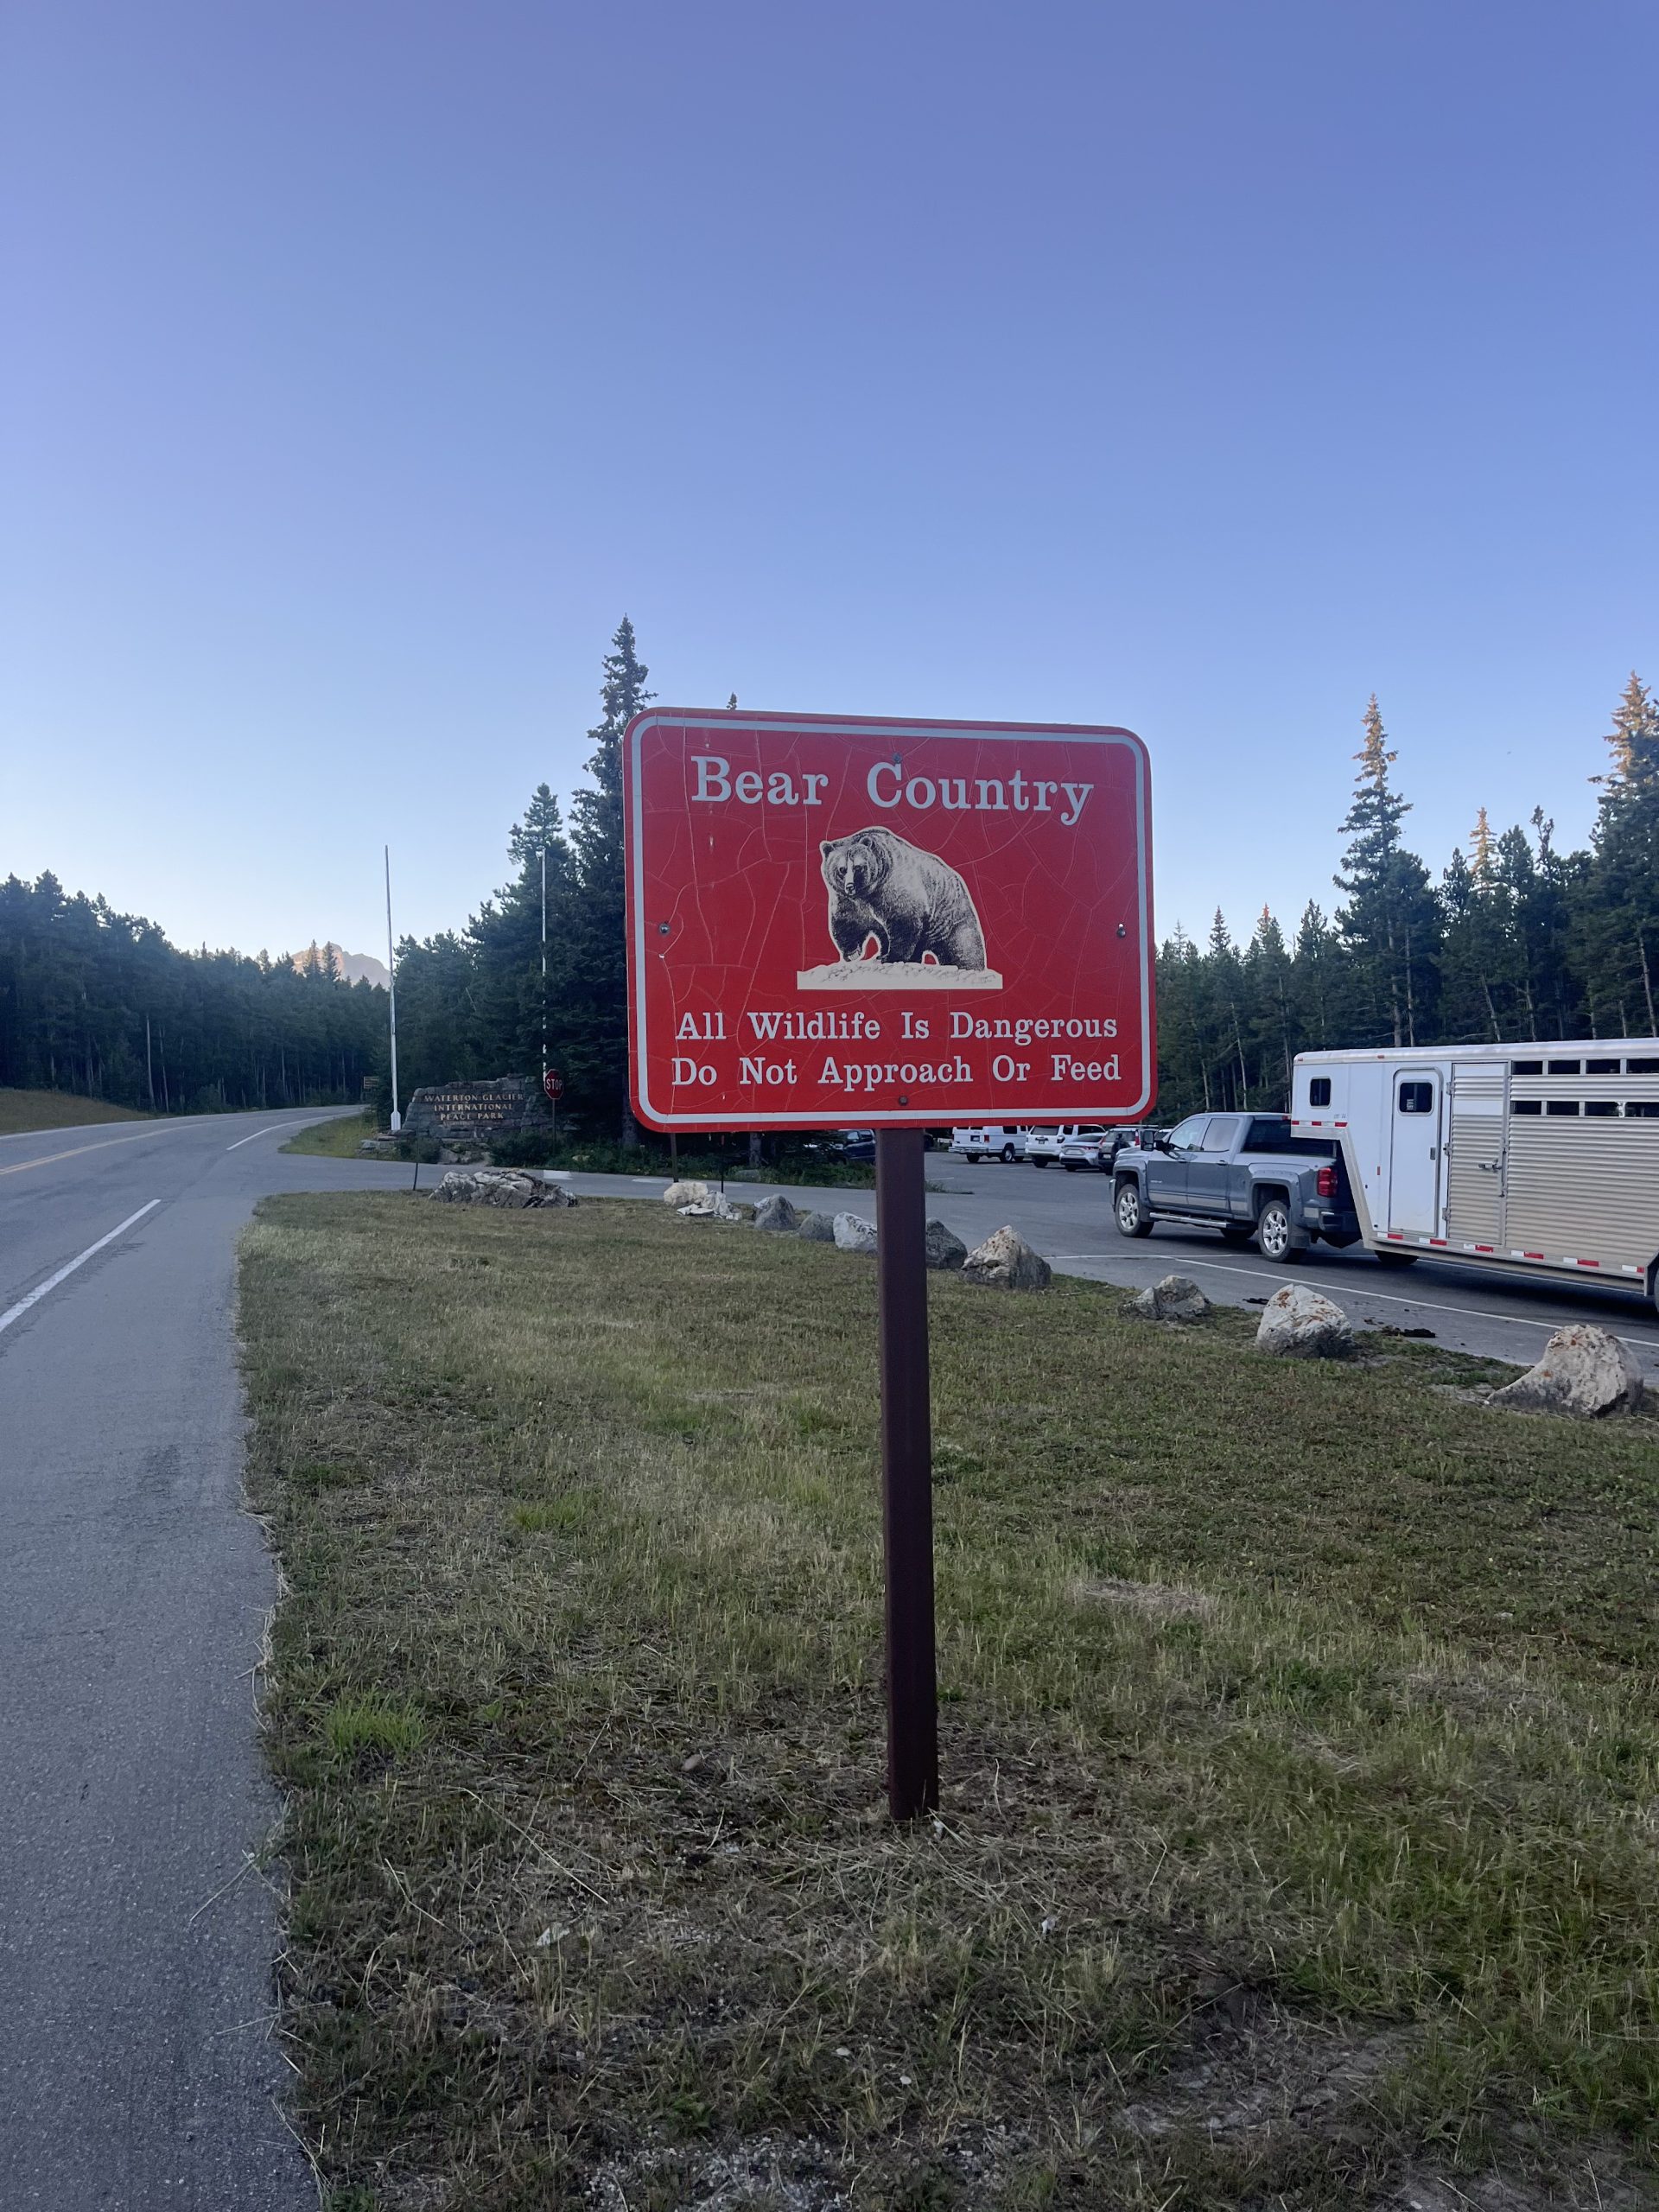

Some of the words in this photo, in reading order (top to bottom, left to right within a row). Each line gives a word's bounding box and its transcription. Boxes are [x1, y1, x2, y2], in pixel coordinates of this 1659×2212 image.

[690, 755, 829, 805] Bear
[867, 761, 1094, 826] Country
[675, 1012, 727, 1039] All
[747, 1012, 880, 1039] Wildlife
[901, 1012, 930, 1039] Is
[950, 1012, 1117, 1046] Dangerous
[546, 1078, 563, 1090] STOP
[671, 1057, 717, 1085] Do
[739, 1057, 798, 1084] Not
[817, 1056, 974, 1092] Approach
[992, 1054, 1031, 1082] Or
[1051, 1054, 1122, 1081] Feed
